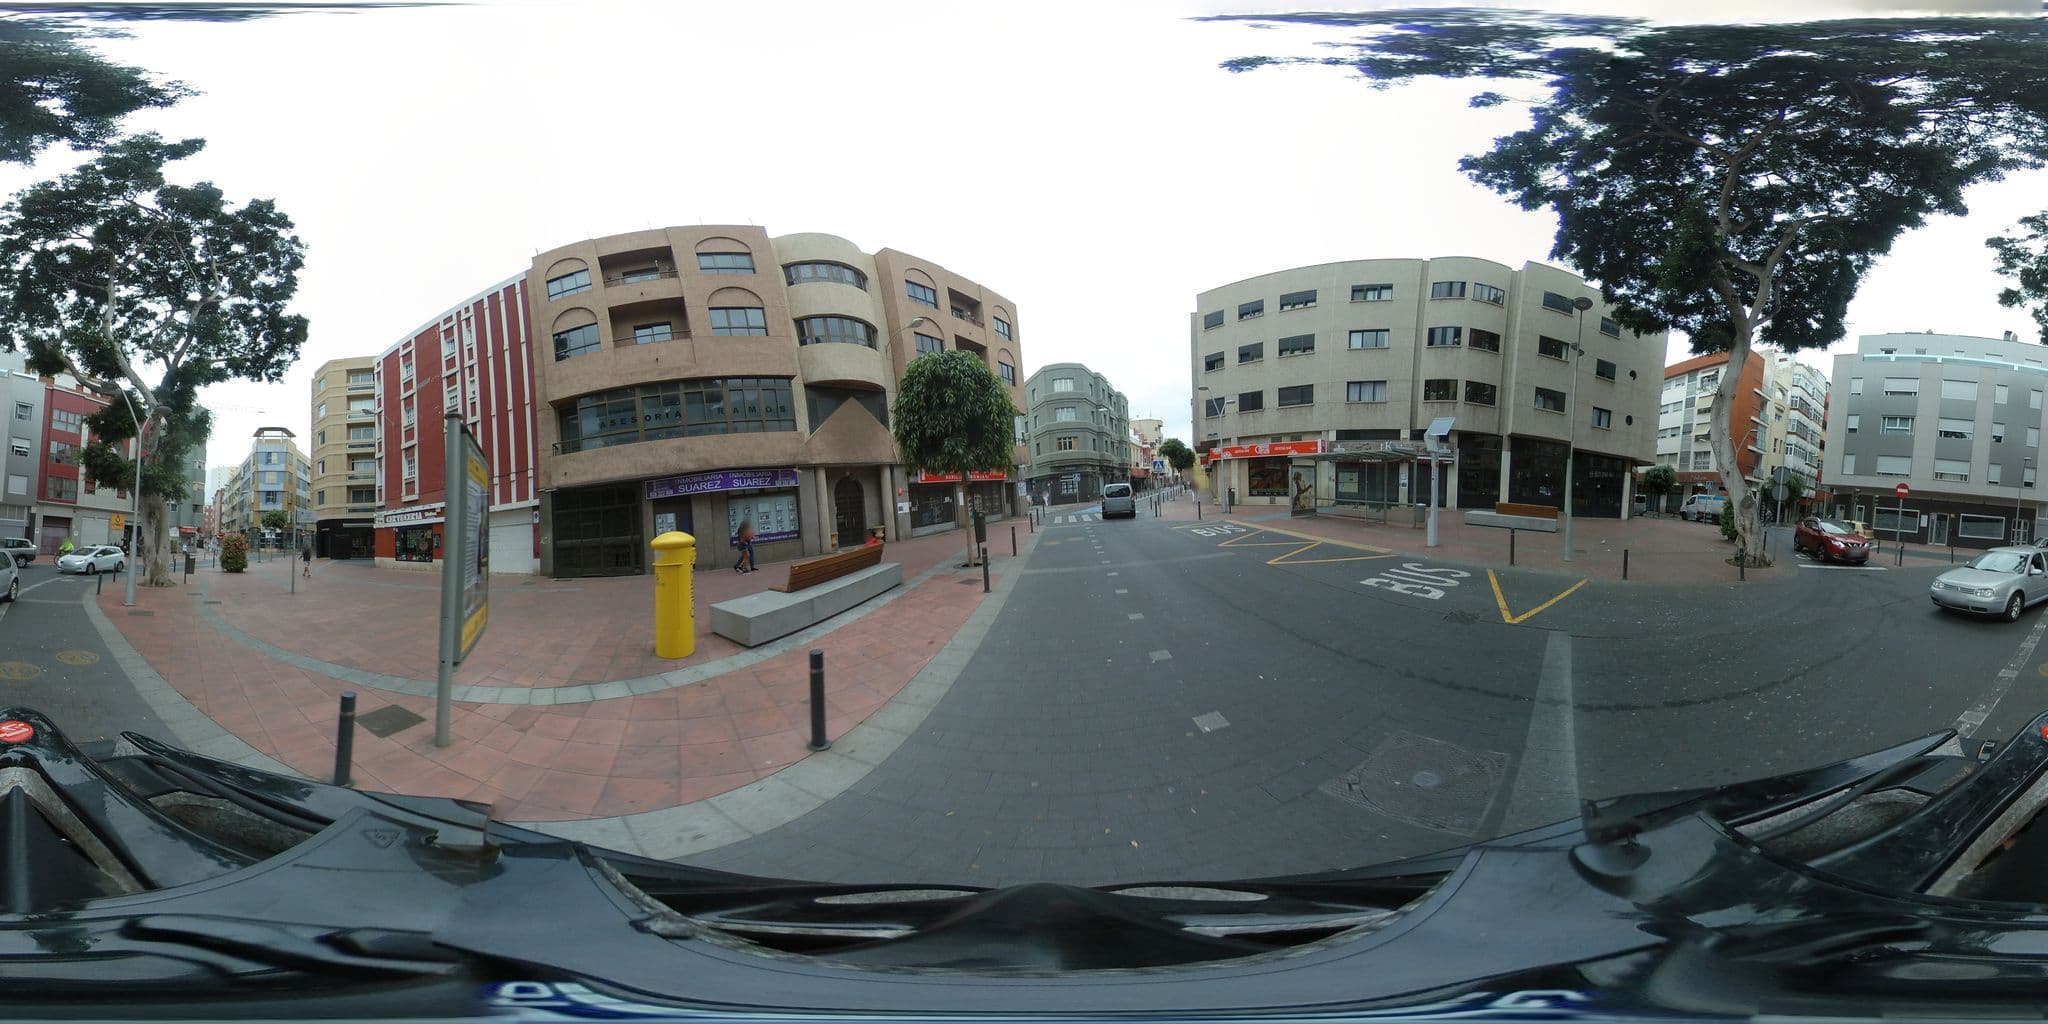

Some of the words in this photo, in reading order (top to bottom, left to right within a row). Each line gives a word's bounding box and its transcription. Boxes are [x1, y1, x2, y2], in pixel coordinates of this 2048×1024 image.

[600, 411, 682, 429] ASESORIA
[717, 405, 786, 416] RAMOS
[678, 479, 722, 493] SUAREZ
[732, 477, 771, 488] SUAREZ
[1191, 525, 1247, 537] BUS
[1360, 562, 1471, 600] BUS
